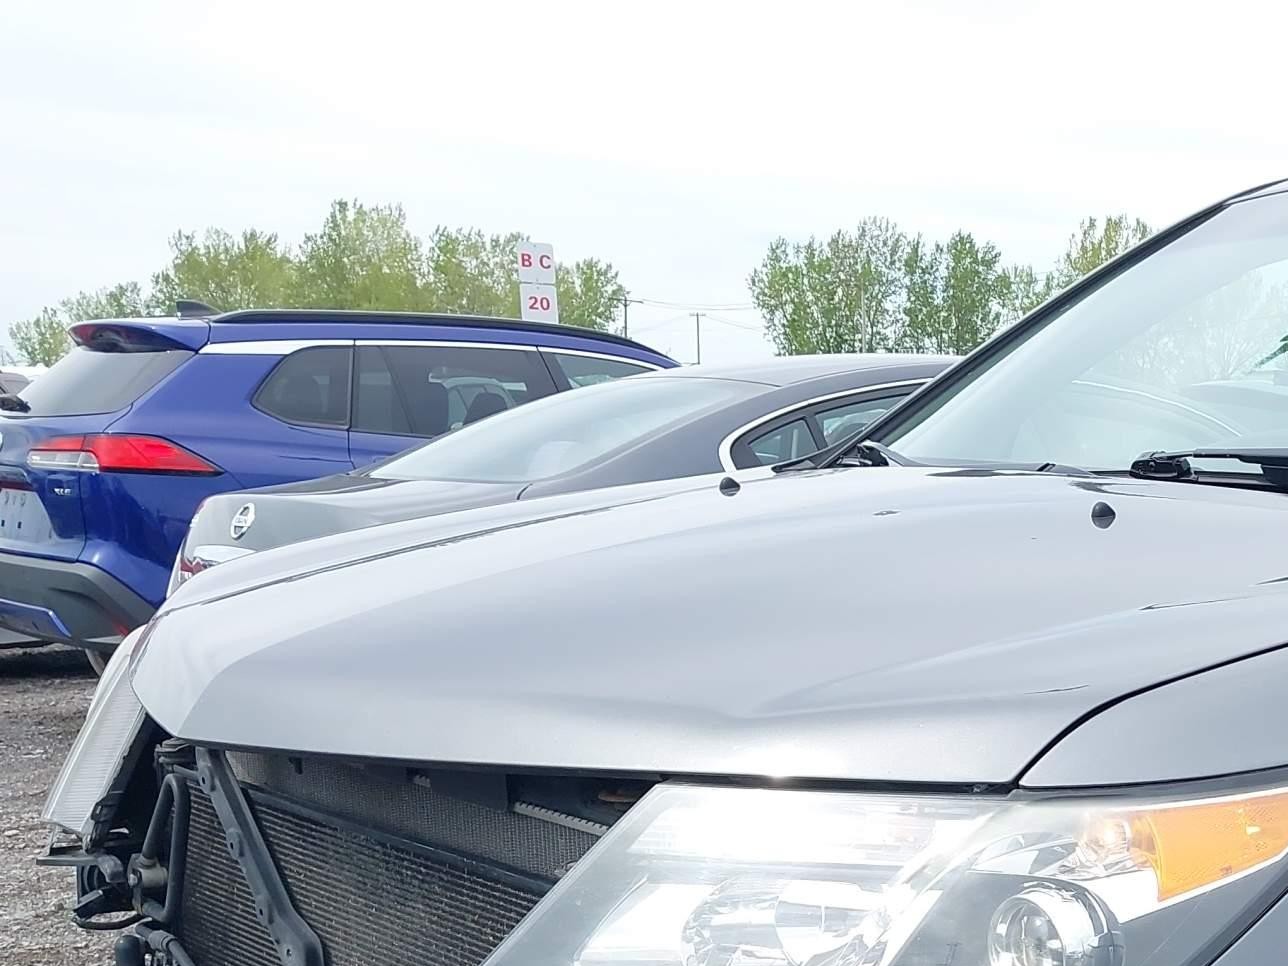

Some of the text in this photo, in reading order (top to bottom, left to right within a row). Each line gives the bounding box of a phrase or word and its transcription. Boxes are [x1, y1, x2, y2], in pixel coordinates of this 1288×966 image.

[521, 253, 551, 269] B C
[528, 296, 550, 311] 20
